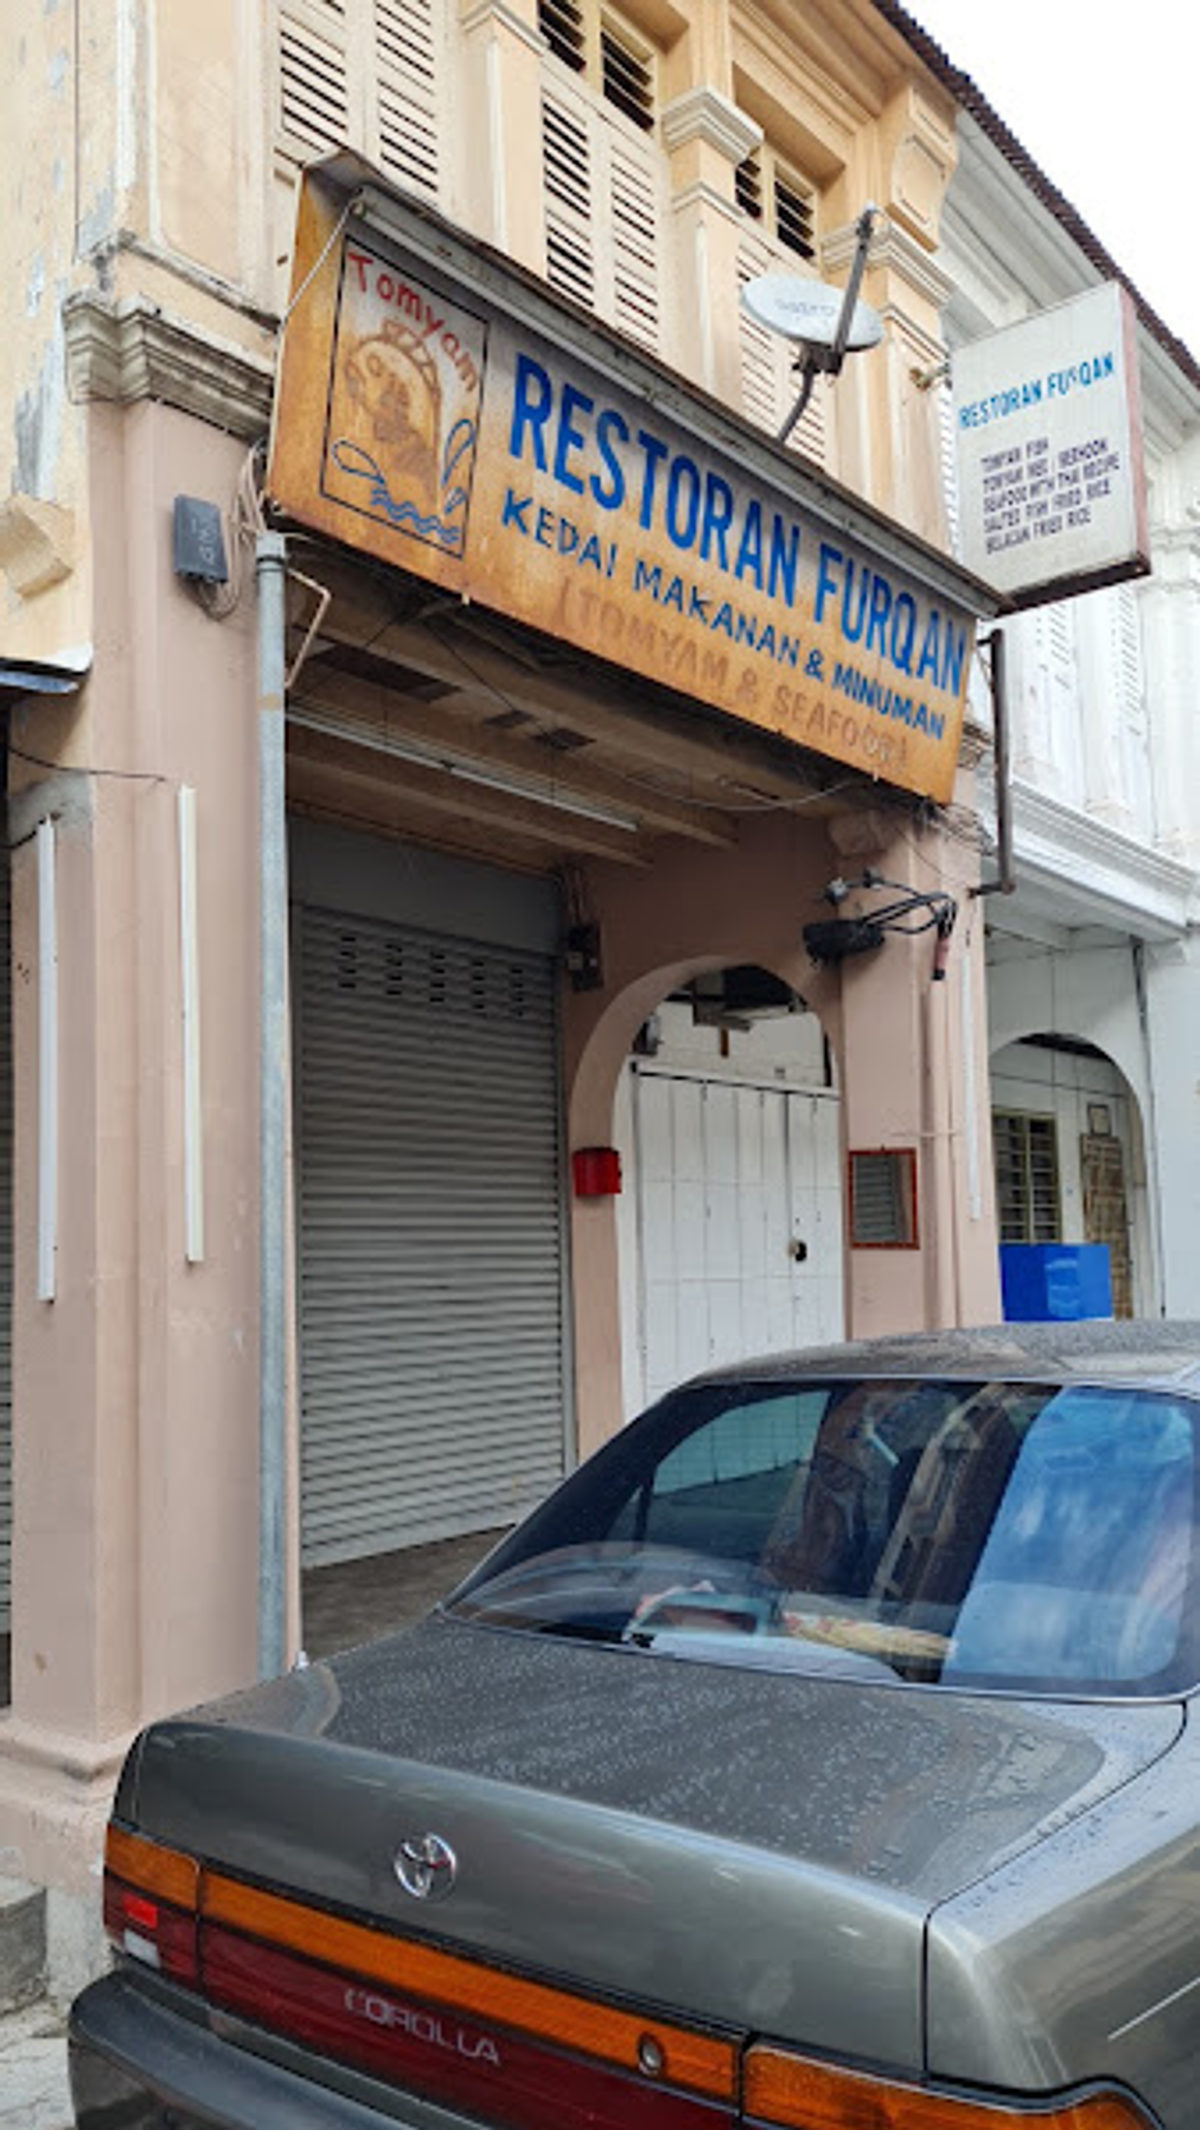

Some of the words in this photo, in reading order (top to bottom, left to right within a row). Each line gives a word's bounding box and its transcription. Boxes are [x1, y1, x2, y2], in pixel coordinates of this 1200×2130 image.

[347, 251, 478, 393] Tomyam
[958, 379, 1042, 430] RESTORAN
[508, 353, 799, 608] RESTORAN
[813, 541, 966, 697] FURQAN
[502, 489, 617, 579] KEDAI
[633, 560, 800, 669] MAKANAN
[803, 649, 825, 682] &
[831, 663, 946, 740] MINUMAN
[344, 1987, 500, 2066] COROLLA
